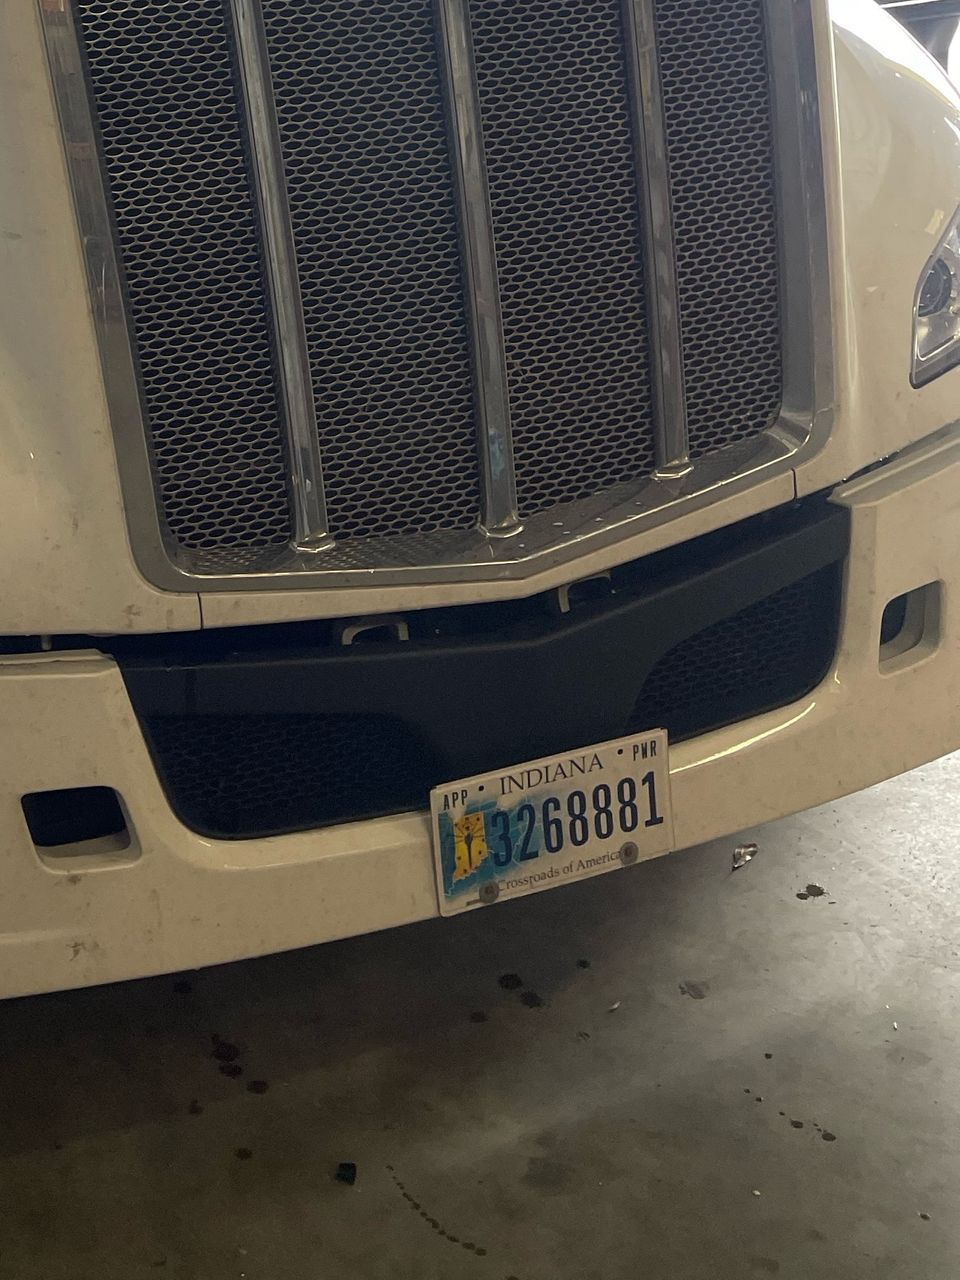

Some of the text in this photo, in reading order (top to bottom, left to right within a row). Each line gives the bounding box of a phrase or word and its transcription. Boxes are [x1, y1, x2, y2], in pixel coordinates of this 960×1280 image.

[443, 740, 658, 811] APP INDIANA PWR
[491, 770, 664, 867] 3268881
[498, 850, 621, 892] Crossroads of America
